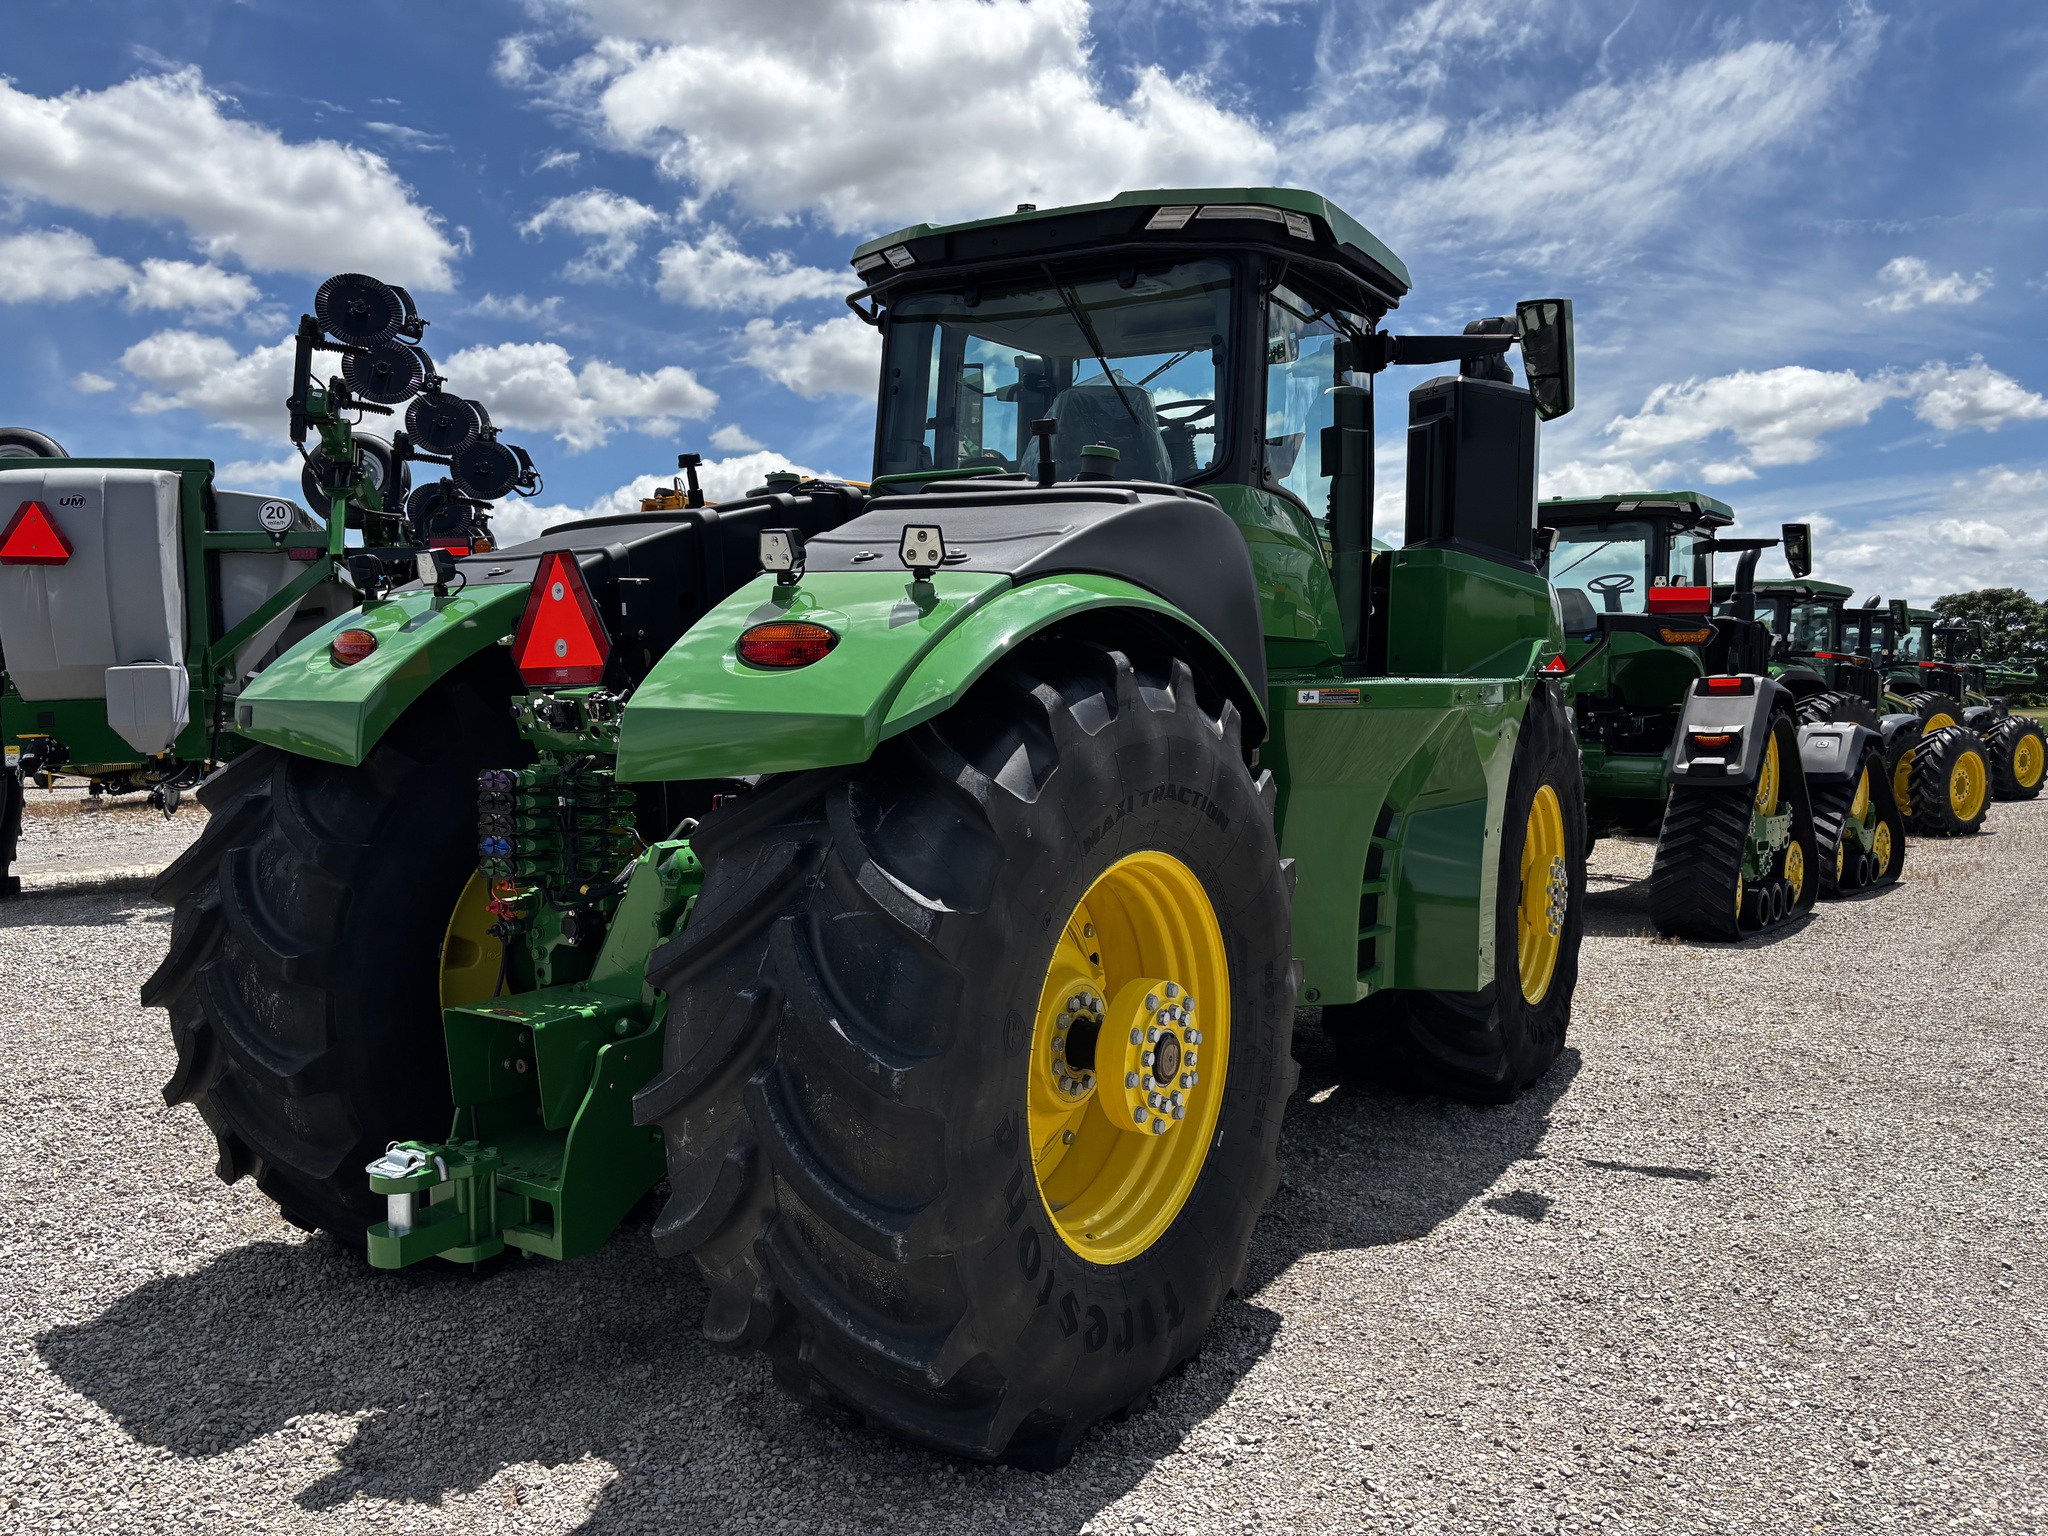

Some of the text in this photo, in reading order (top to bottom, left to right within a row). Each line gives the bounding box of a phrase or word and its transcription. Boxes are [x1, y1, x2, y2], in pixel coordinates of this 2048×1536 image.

[265, 506, 286, 520] 20
[1083, 783, 1231, 855] MAXI TRACTION
[994, 1111, 1186, 1355] Firestone
